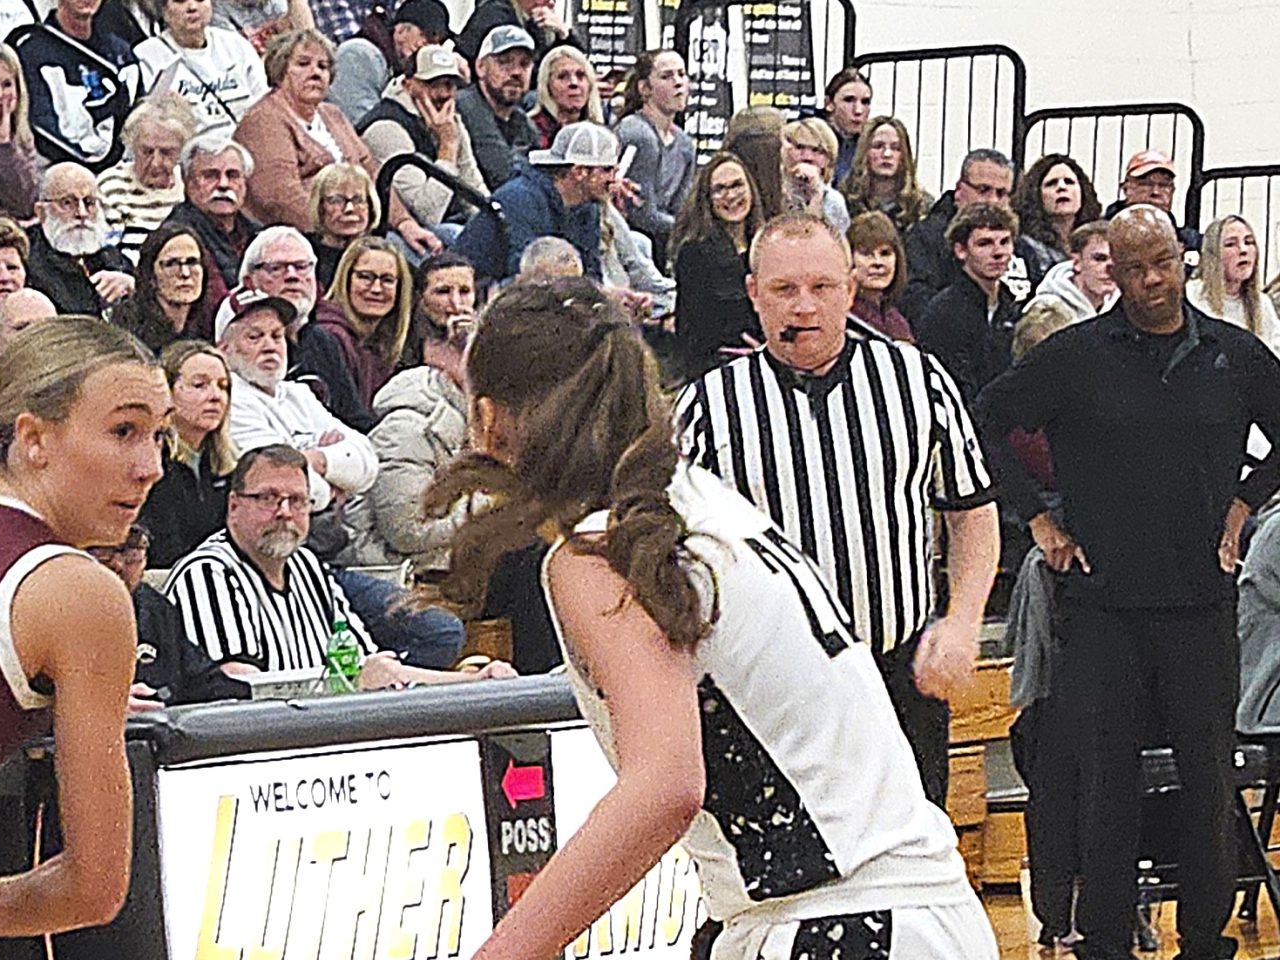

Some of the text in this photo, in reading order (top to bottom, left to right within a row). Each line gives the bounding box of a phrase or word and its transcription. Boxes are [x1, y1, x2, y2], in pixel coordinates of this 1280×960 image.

[249, 769, 392, 813] WELCOME TO
[500, 817, 552, 855] POSS
